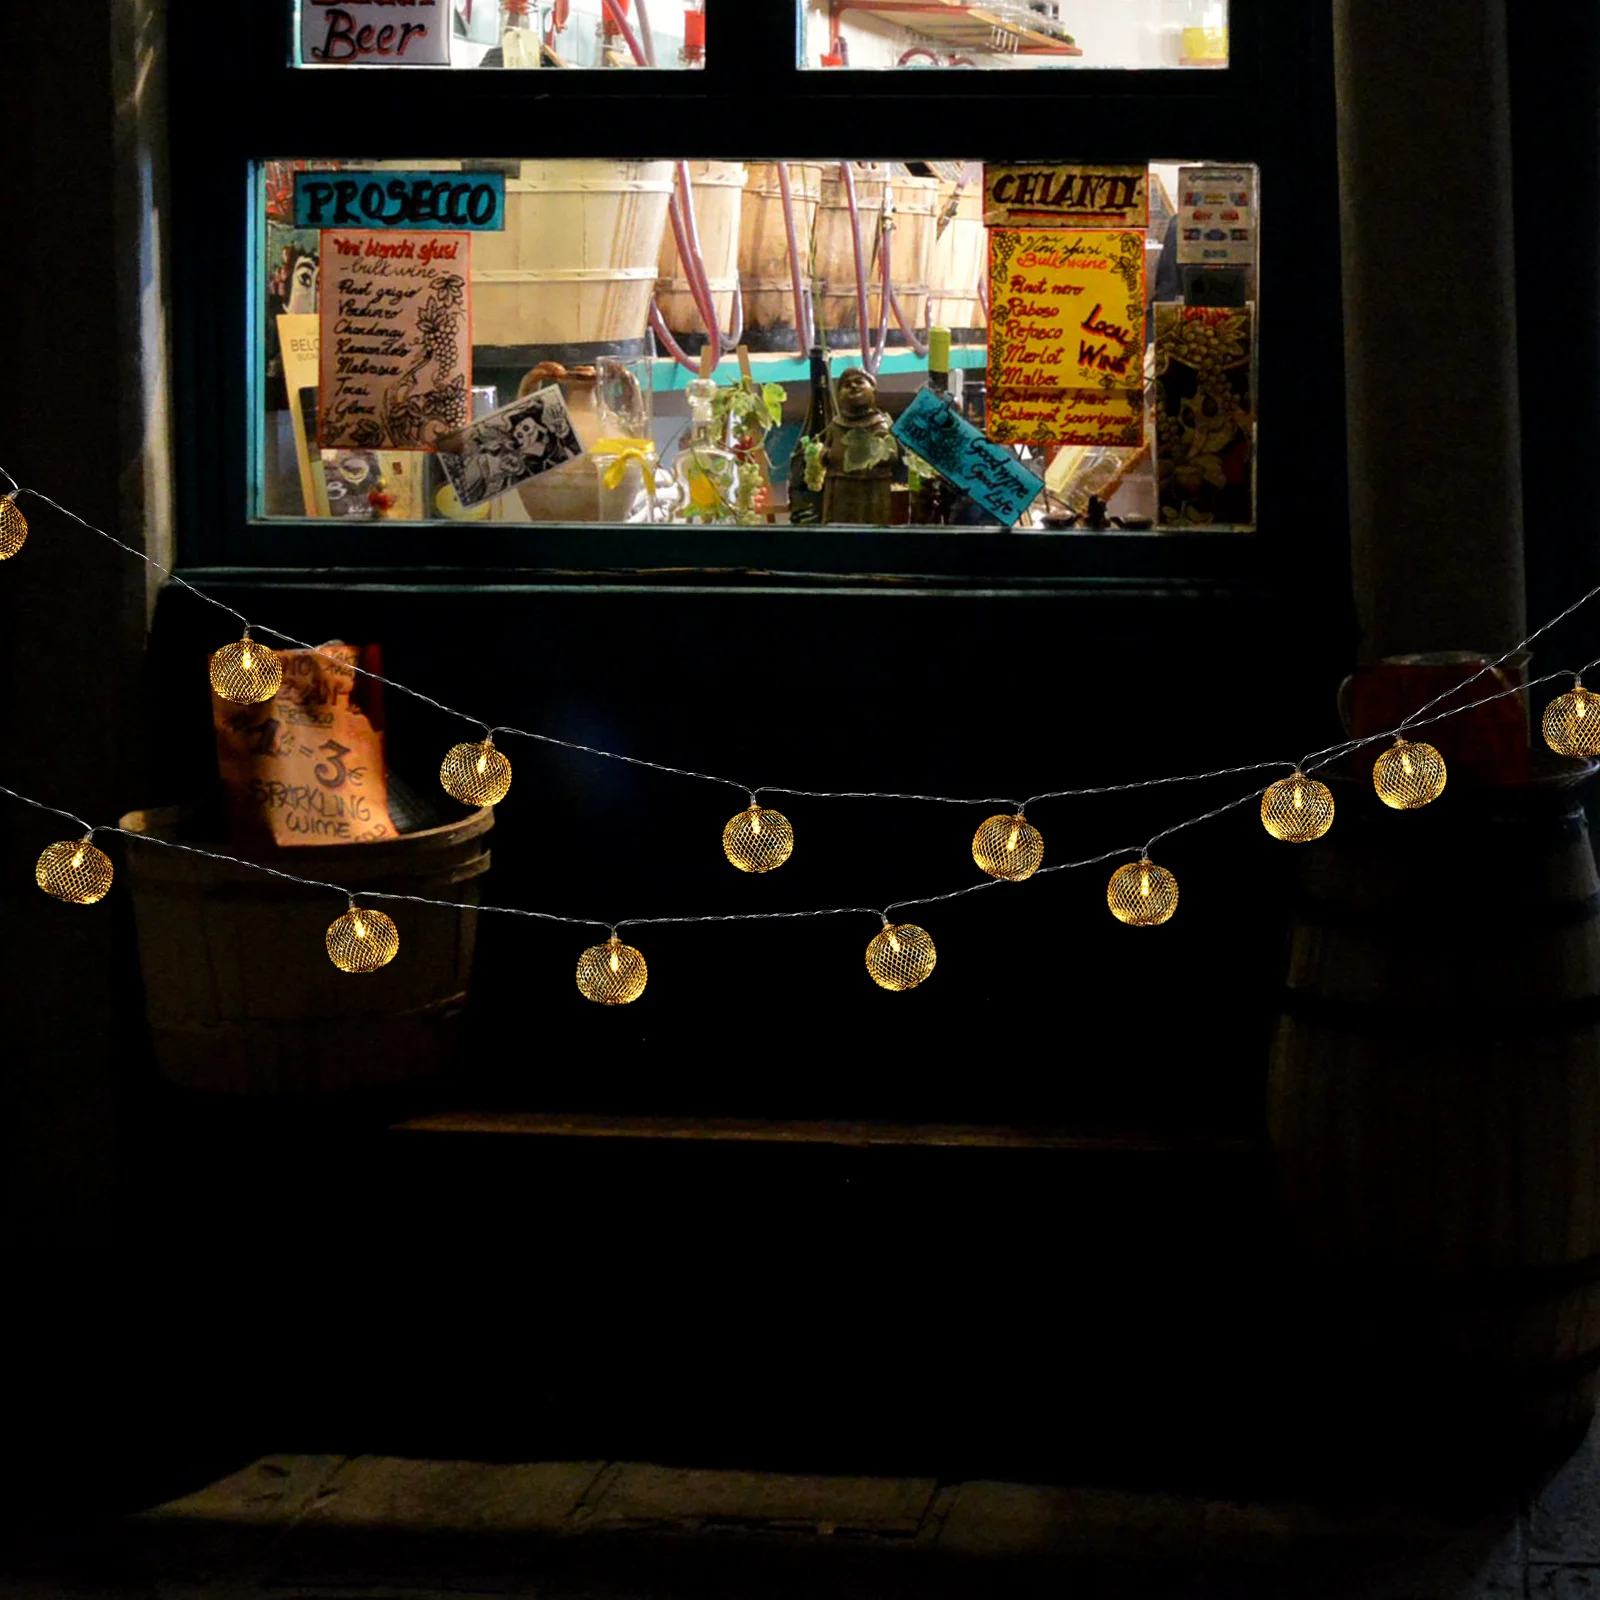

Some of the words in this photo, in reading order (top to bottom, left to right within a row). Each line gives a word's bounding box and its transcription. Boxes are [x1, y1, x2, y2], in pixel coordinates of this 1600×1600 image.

[311, 8, 428, 62] Beer
[992, 171, 1143, 209] CHIANTI
[303, 179, 496, 225] PROSECCO
[365, 236, 415, 259] bianchi
[1051, 283, 1085, 296] nero
[1007, 297, 1059, 318] Raboso
[1004, 319, 1063, 343] Refosco
[1002, 344, 1065, 365] Merlot
[1001, 366, 1060, 387] Malbec
